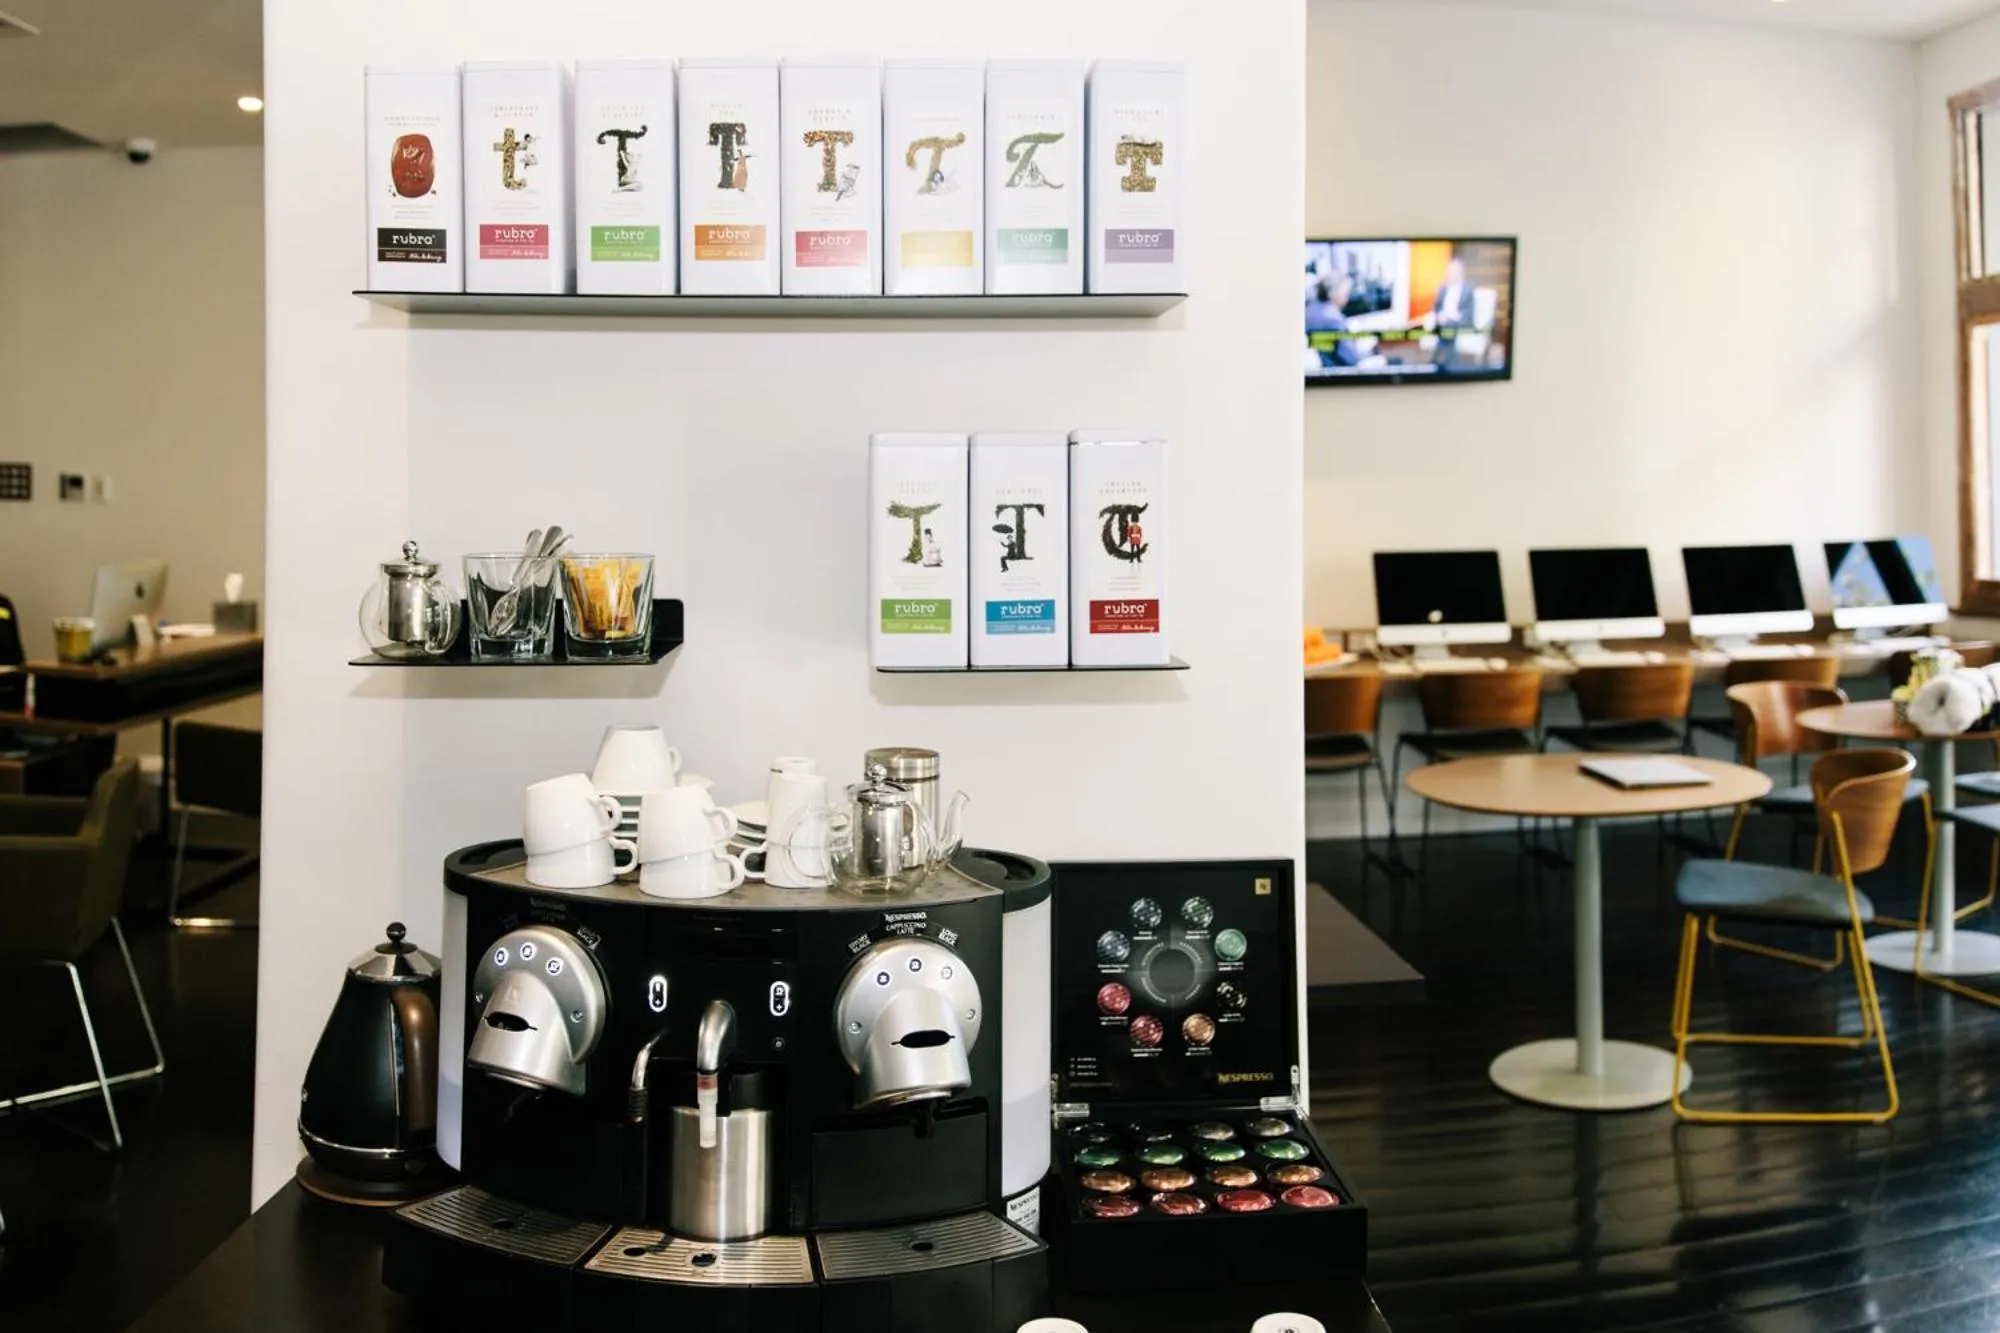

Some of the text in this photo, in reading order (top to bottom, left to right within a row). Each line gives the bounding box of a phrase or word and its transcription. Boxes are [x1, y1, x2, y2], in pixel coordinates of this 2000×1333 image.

[884, 912, 927, 922] NESPRESSO
[885, 922, 927, 931] CAPPUCCINO
[1217, 1072, 1274, 1083] NESPRESSO
